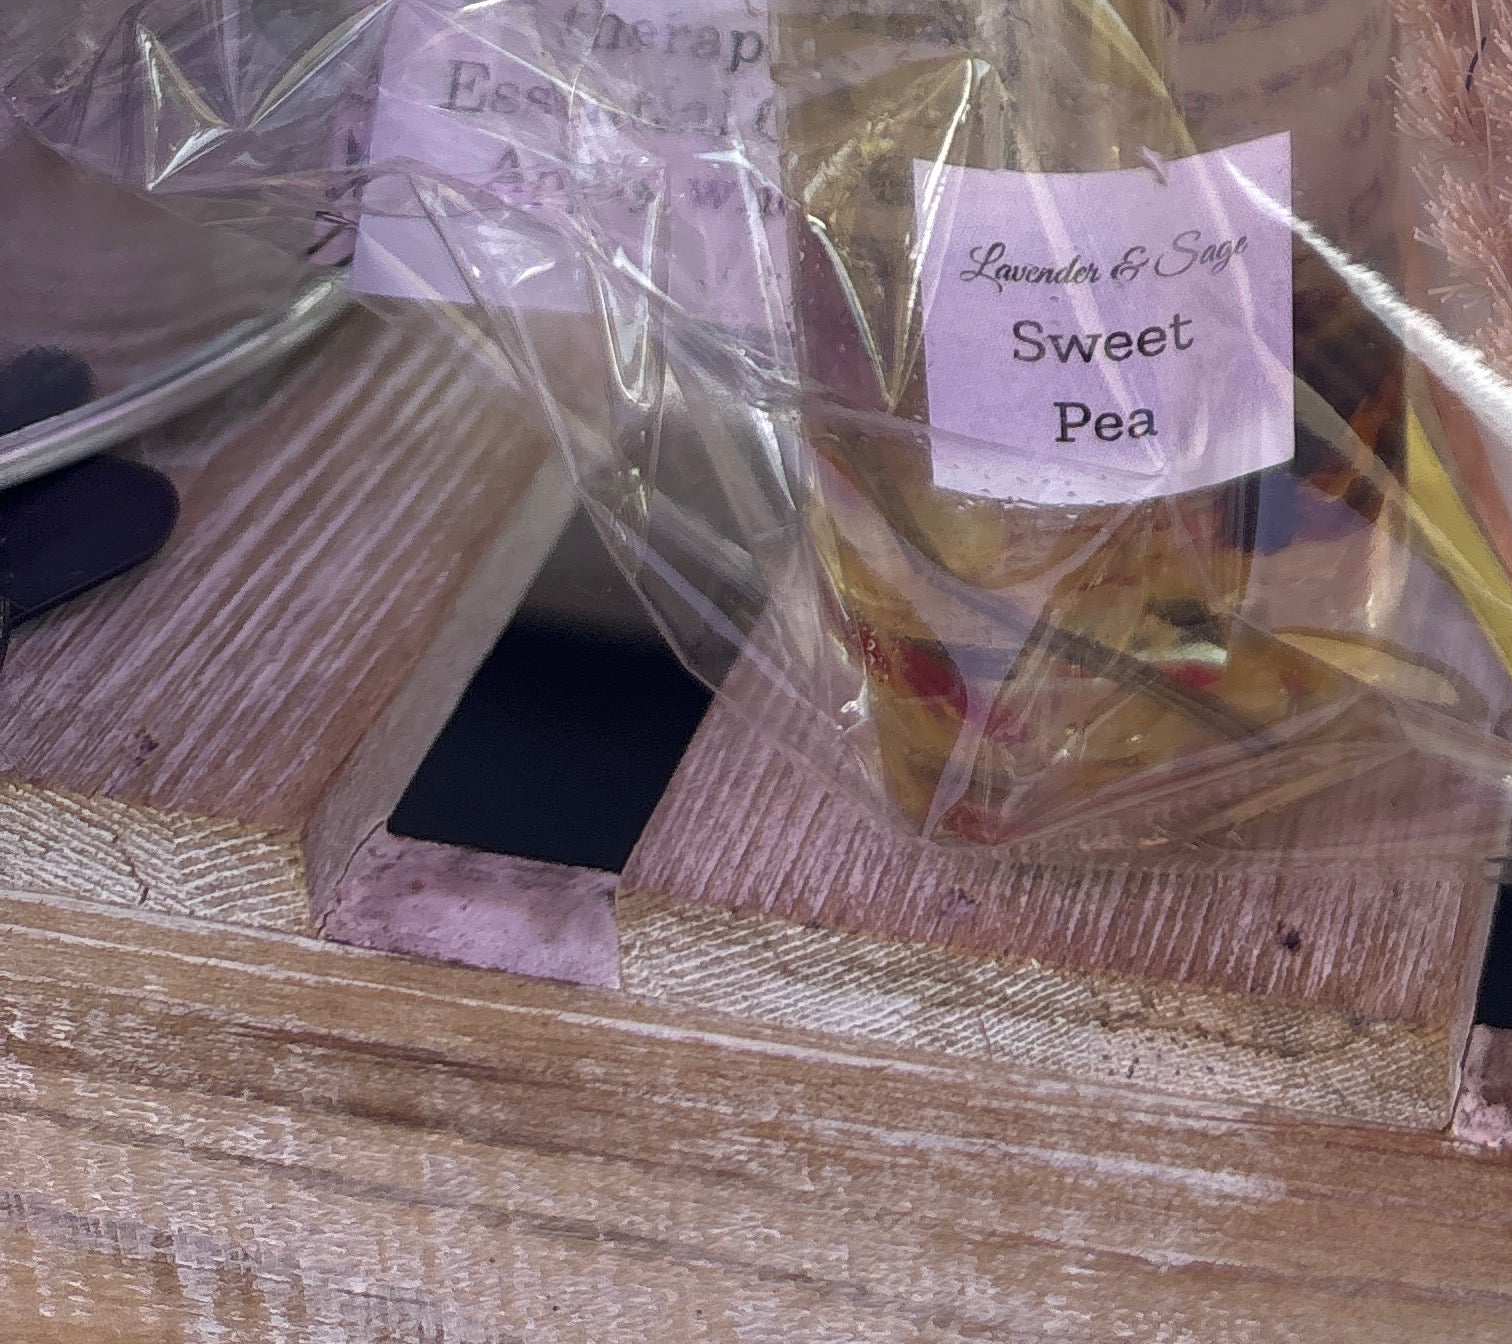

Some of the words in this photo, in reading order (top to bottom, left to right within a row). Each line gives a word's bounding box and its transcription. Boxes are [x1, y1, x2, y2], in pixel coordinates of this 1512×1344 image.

[960, 241, 1100, 292] Lavender
[1110, 246, 1151, 282] &
[1154, 229, 1249, 278] Sage
[1012, 313, 1195, 363] Sweet
[1053, 401, 1159, 444] Pea
